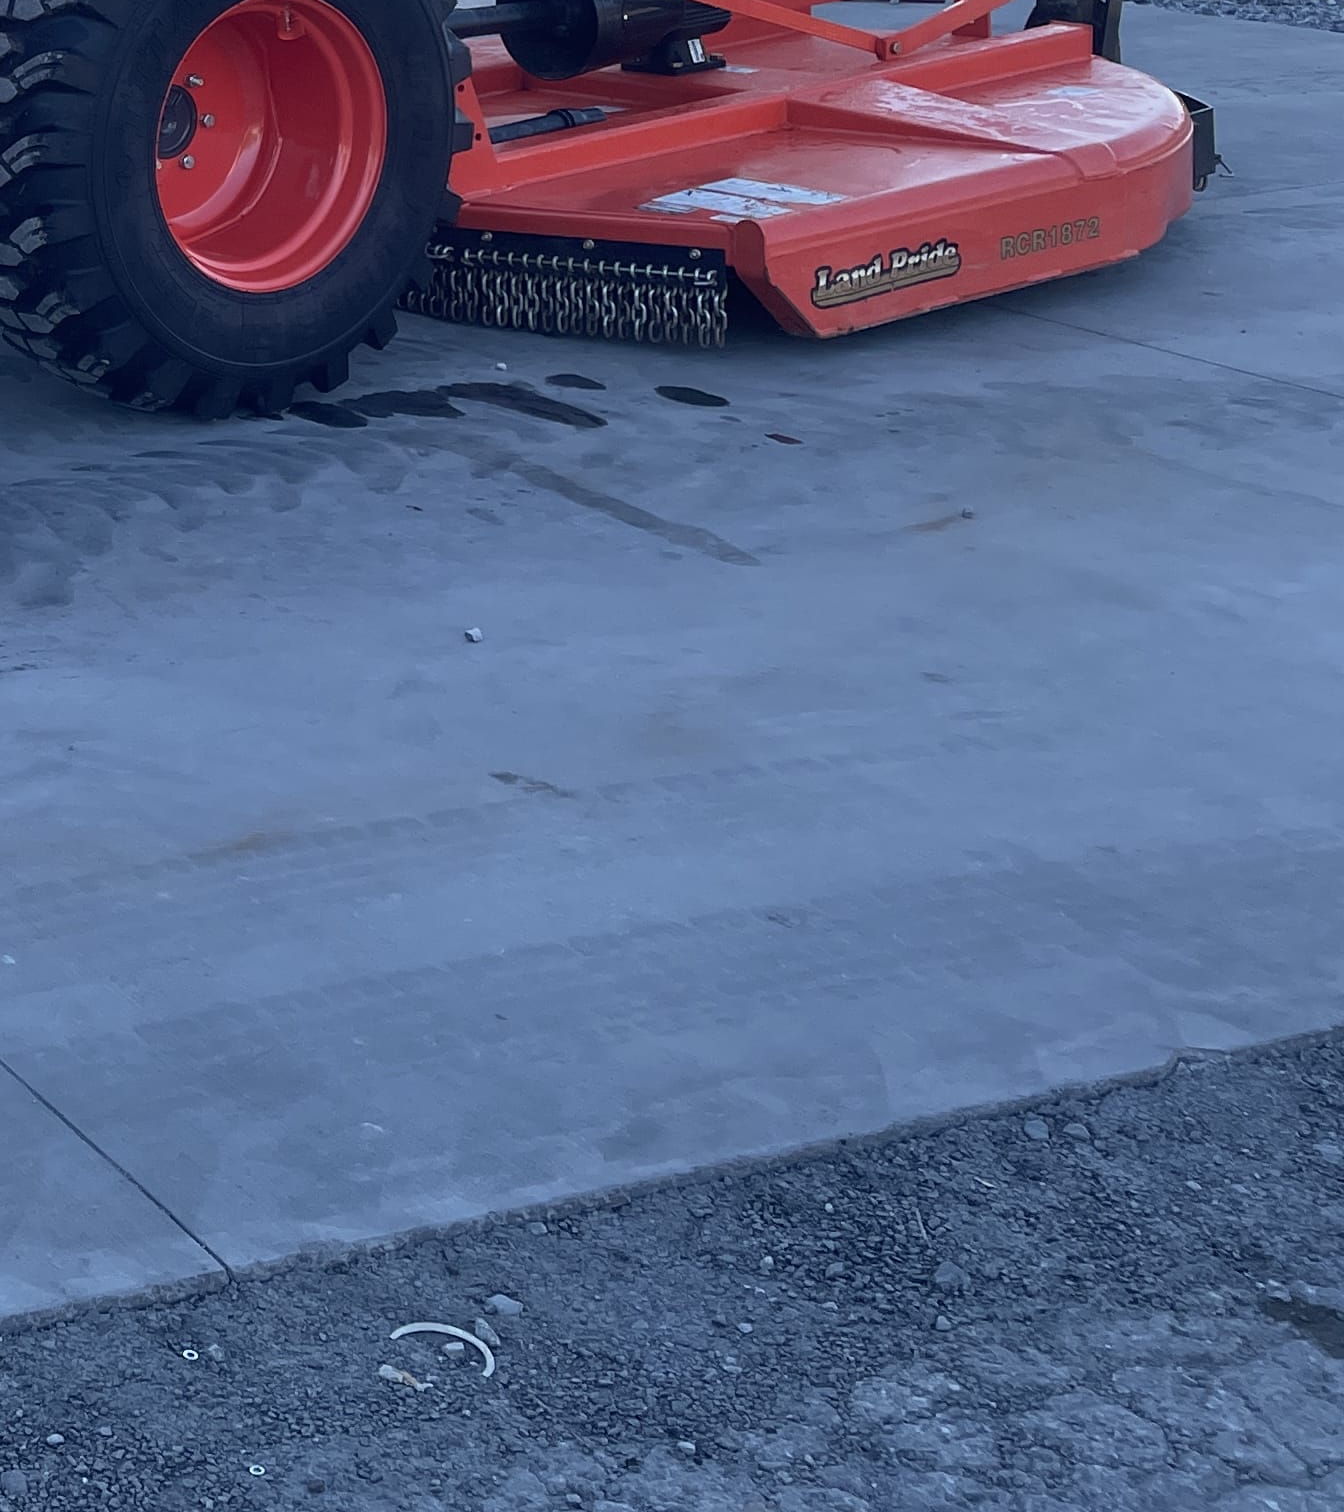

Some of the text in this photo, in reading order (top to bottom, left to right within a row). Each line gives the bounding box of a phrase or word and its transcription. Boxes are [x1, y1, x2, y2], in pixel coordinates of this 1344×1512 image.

[1001, 216, 1100, 259] RCR1872
[816, 241, 960, 297] Land Pride
